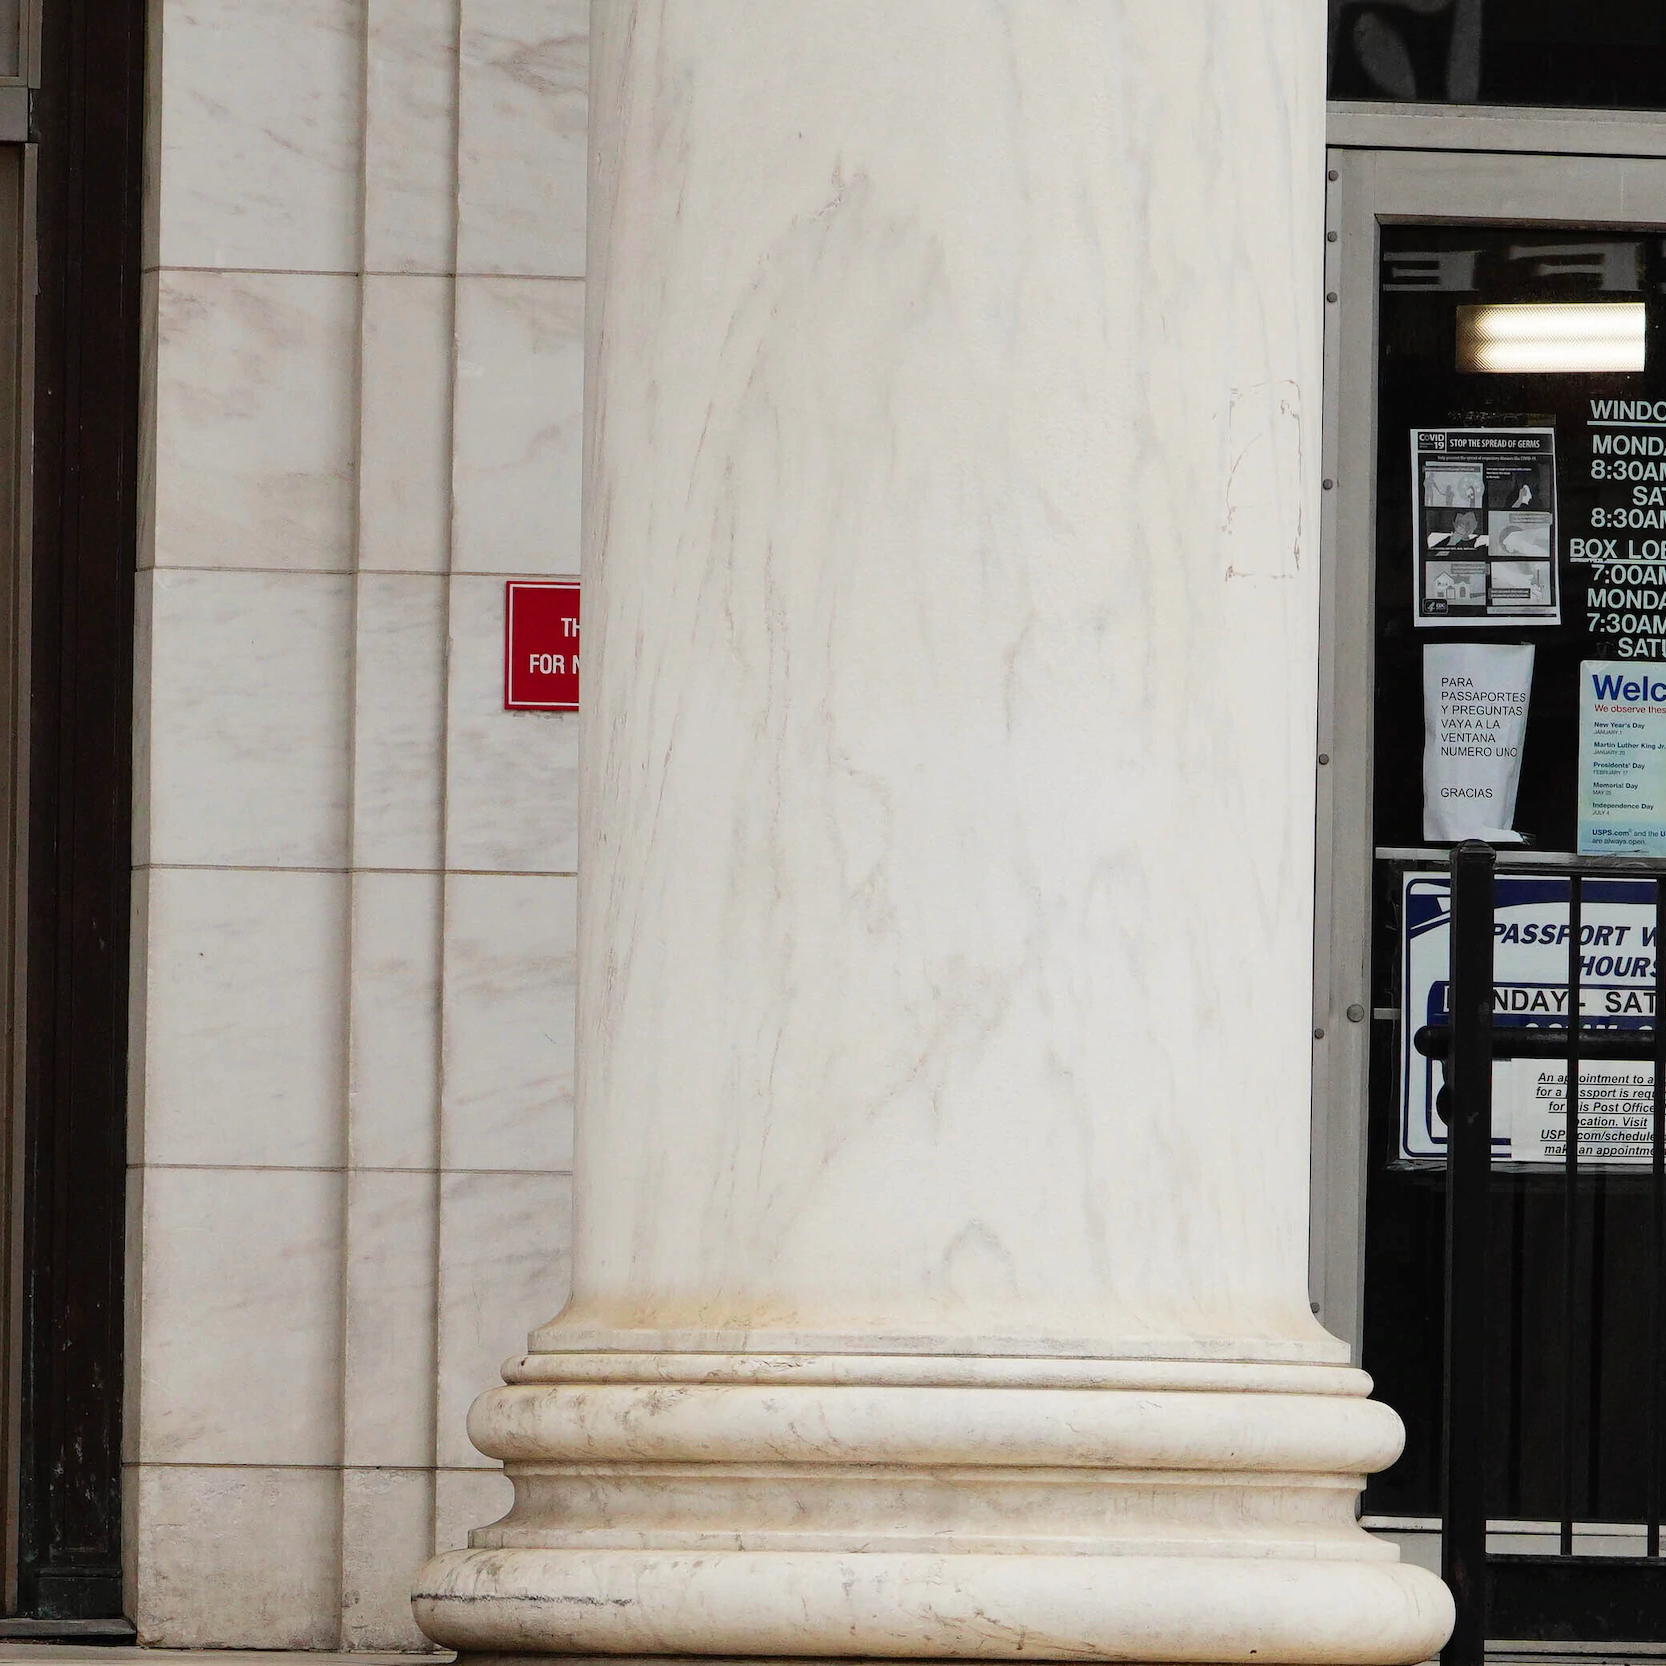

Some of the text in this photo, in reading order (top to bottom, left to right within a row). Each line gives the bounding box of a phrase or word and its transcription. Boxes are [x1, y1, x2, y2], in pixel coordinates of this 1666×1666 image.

[1419, 433, 1445, 442] COVID
[1434, 441, 1445, 450] 19
[1449, 439, 1541, 449] STOP THE SPREAD OF GERMS
[1569, 538, 1617, 558] BOX
[529, 653, 566, 675] FOR
[1441, 677, 1474, 688] PARA
[1441, 691, 1526, 703] PASSAPORTES
[1441, 705, 1523, 716] Y PREGUNTAS
[1594, 704, 1609, 713] We
[1611, 705, 1646, 714] observe
[1441, 719, 1501, 729] VAYA A LA
[1441, 733, 1496, 743] VENTANA
[1441, 747, 1518, 758] NUMERO UNO
[1441, 787, 1493, 798] GRACIAS
[1641, 803, 1655, 811] Day
[1603, 838, 1627, 846] always
[1538, 1072, 1644, 1084] An to
[1536, 1086, 1629, 1098] for a is
[1549, 1101, 1565, 1111] for
[1593, 1102, 1619, 1112] Post
[1623, 1116, 1648, 1127] Visit
[1579, 1147, 1593, 1155] an
